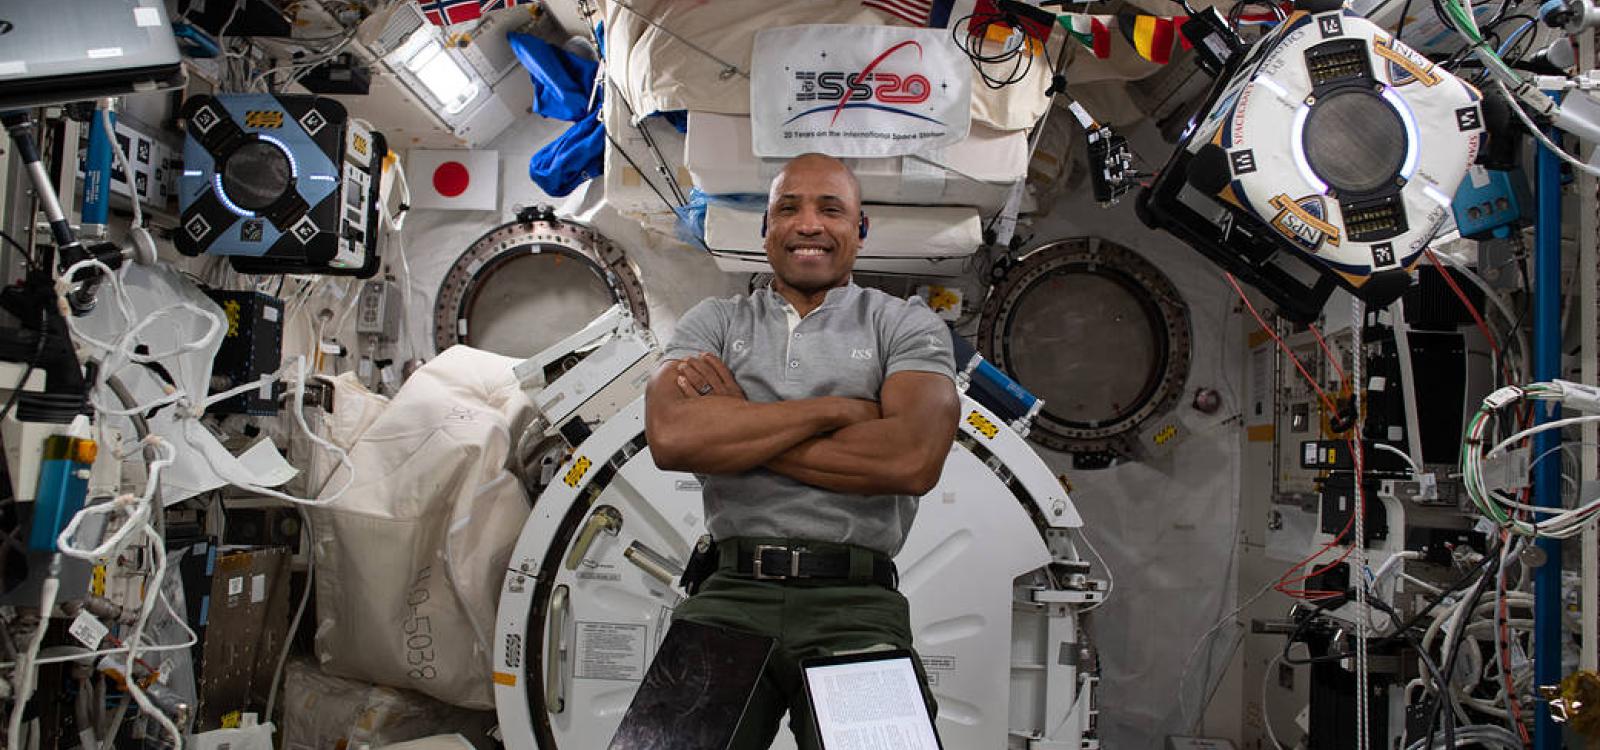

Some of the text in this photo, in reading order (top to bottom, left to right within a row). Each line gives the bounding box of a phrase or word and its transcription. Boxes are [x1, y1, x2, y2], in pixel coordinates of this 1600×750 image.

[843, 131, 891, 139] International
[892, 132, 917, 140] Space
[1283, 214, 1319, 240] NPS
[850, 349, 872, 360] ISS
